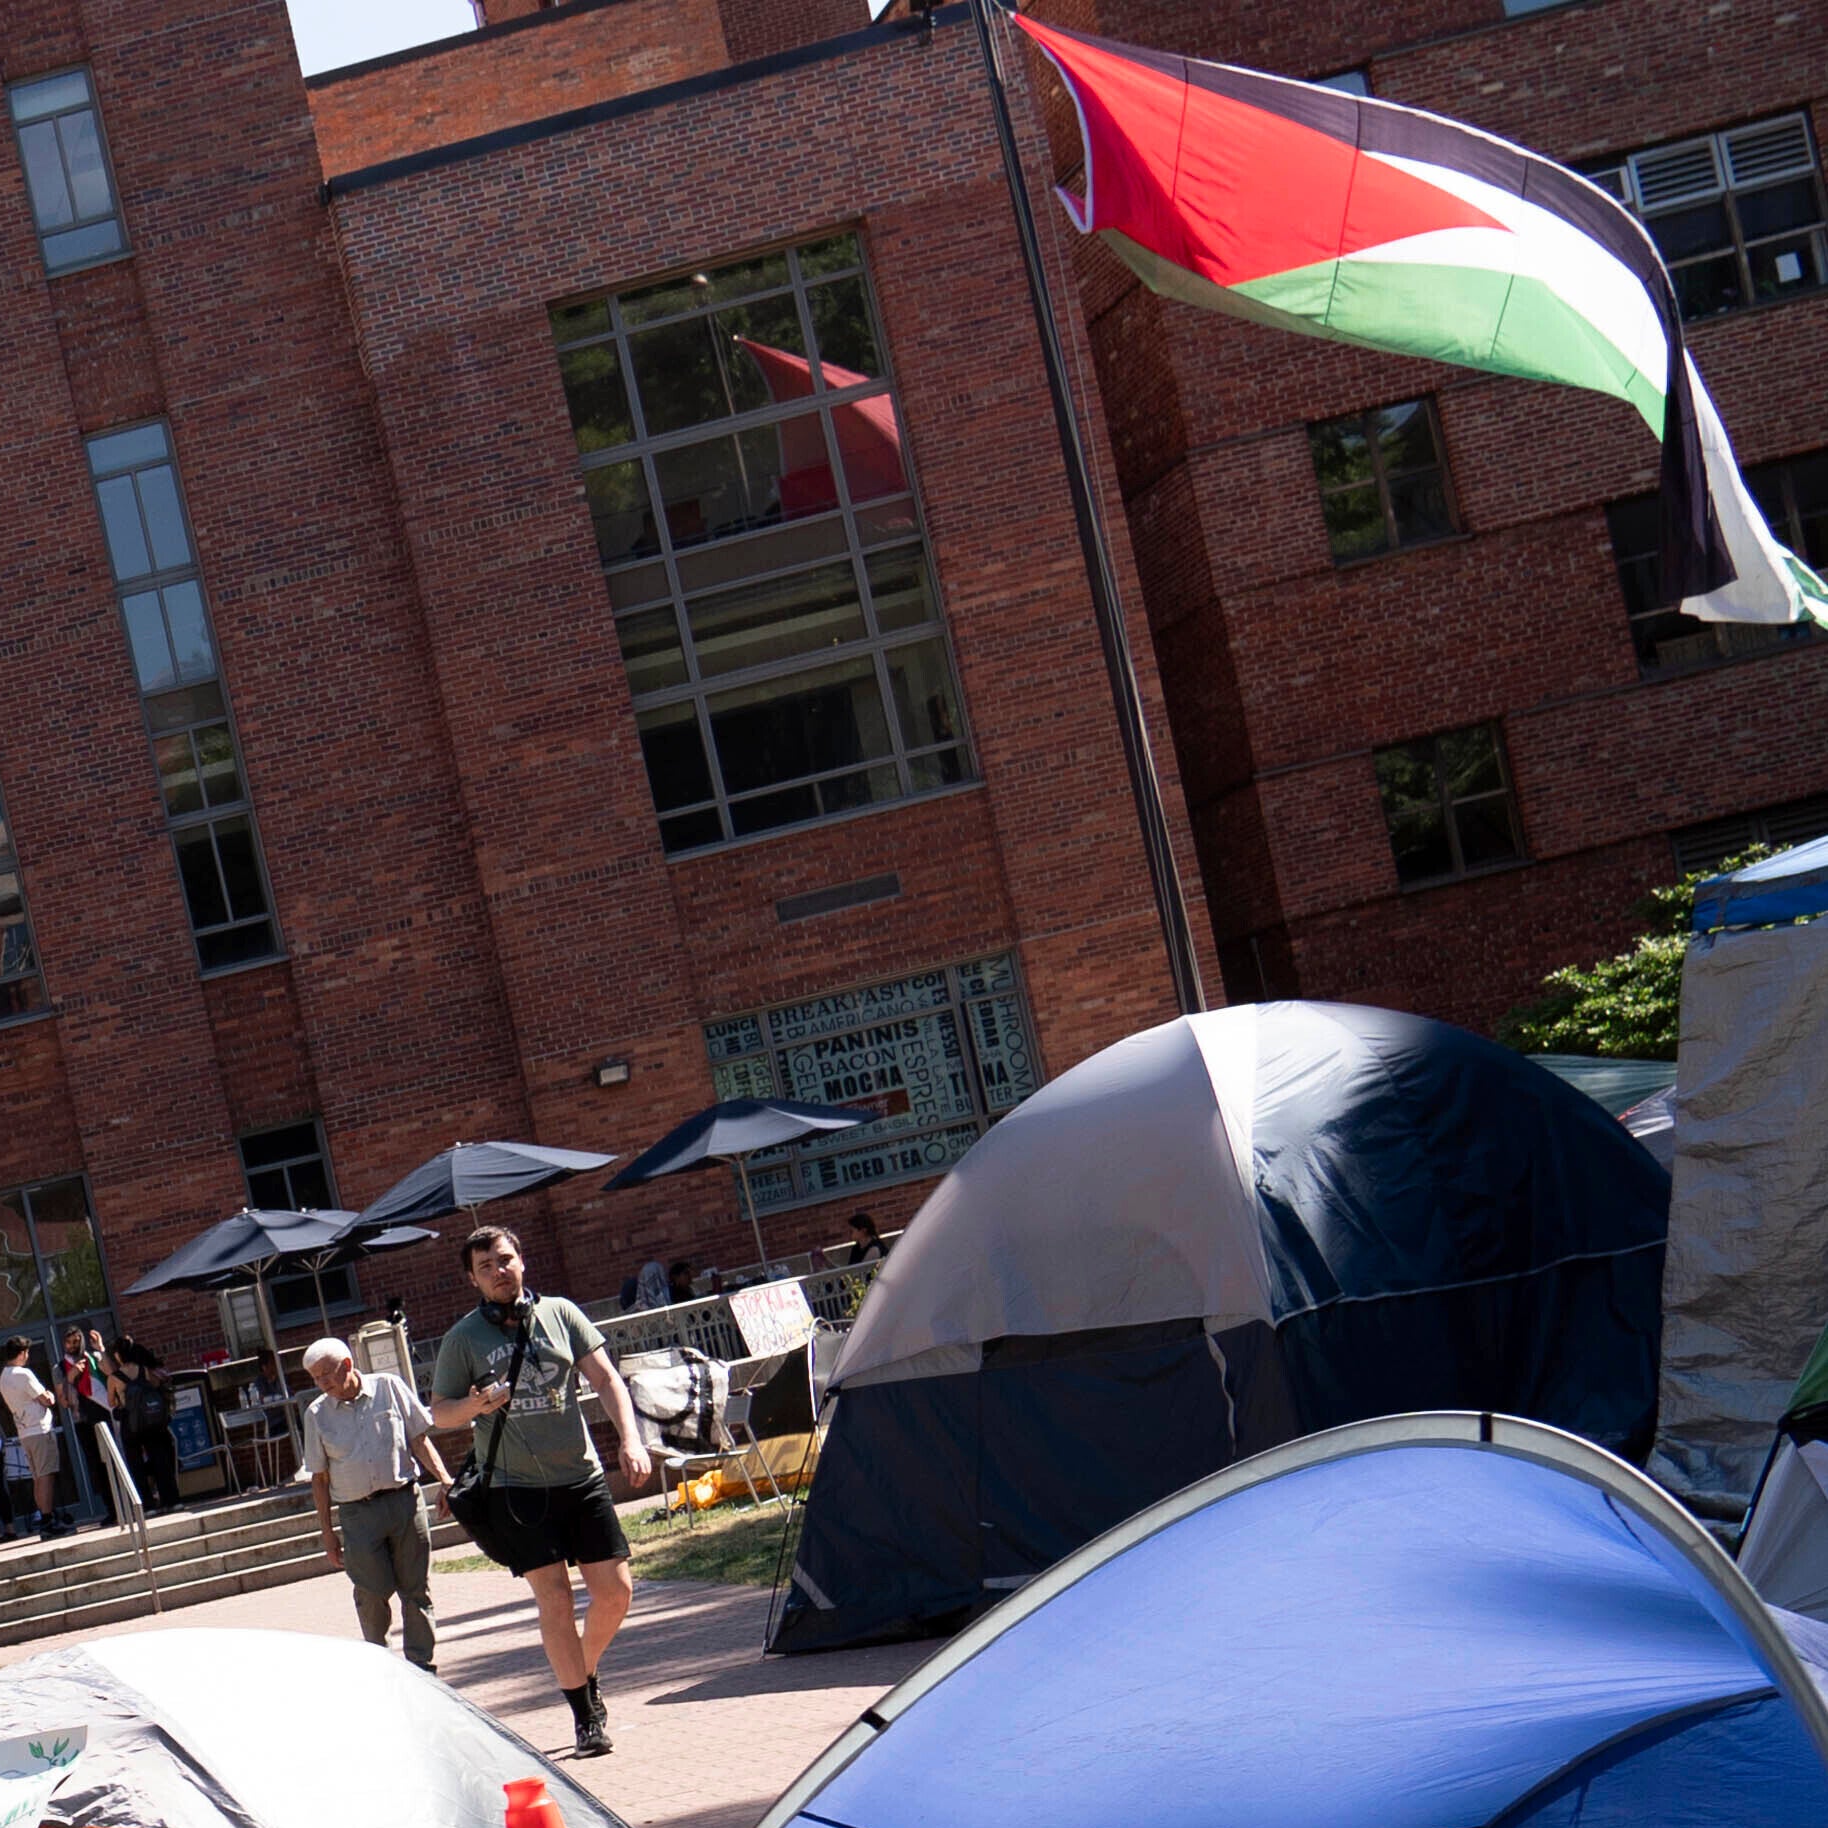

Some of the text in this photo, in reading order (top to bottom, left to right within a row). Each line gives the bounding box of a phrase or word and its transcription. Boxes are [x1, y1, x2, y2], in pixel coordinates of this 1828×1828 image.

[767, 979, 911, 1028] BREAKFAST
[806, 996, 915, 1035] AMERICANO
[813, 1018, 920, 1060] PANINIS
[818, 1045, 897, 1078] BACON
[823, 1063, 904, 1102] MOCHA
[840, 1155, 885, 1183] ICED
[886, 1146, 923, 1173] TEA
